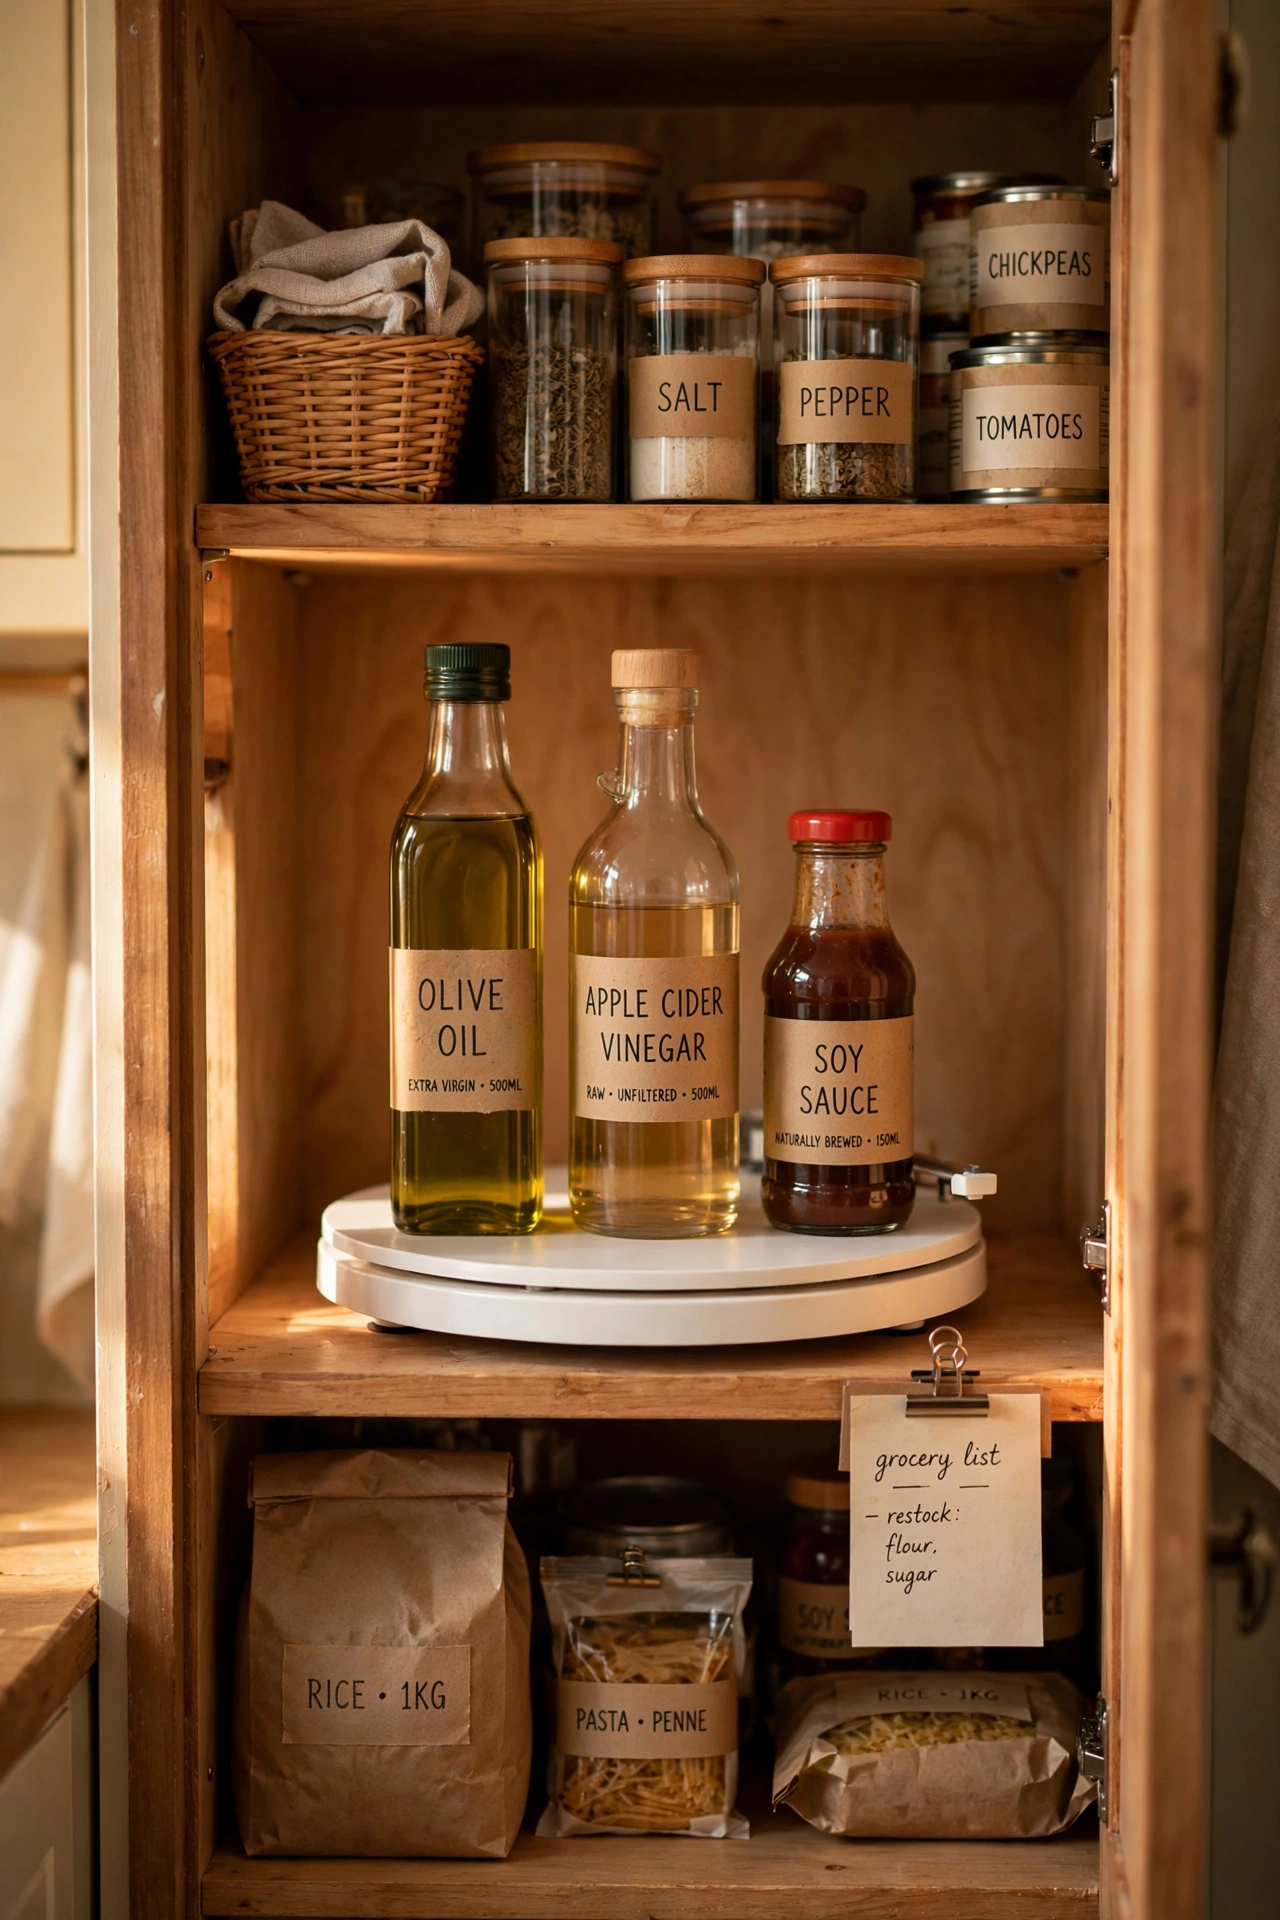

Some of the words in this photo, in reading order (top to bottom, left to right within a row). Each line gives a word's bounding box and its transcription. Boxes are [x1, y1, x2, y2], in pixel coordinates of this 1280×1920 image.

[988, 250, 1092, 279] CHICKPEAS
[657, 381, 723, 413] SALT
[800, 386, 892, 418] PEPPER
[976, 412, 1083, 442] TOMATOES
[418, 978, 504, 1012] OLIVE
[585, 985, 649, 1018] APPLE
[661, 985, 724, 1019] CIDER
[437, 1024, 487, 1057] OIL
[600, 1031, 707, 1064] VINEGAR
[814, 1043, 864, 1074] SOY
[408, 1078, 438, 1093] EXTRA
[441, 1079, 476, 1093] VIRGIN
[489, 1078, 522, 1092] 500ML
[586, 1084, 606, 1101] RAW
[617, 1087, 677, 1103] UNFILTERED
[691, 1085, 720, 1101] 500ML
[799, 1084, 879, 1116] SAUCE
[775, 1131, 821, 1149] NATURALLY
[824, 1134, 863, 1149] BREWED
[875, 1131, 901, 1147] 150ML
[874, 1451, 954, 1483] grocery
[963, 1441, 1001, 1468] list
[885, 1533, 938, 1563] flour,
[885, 1568, 938, 1595] sugar
[797, 1603, 836, 1631] SOY
[307, 1678, 366, 1710] RICE
[401, 1680, 447, 1711] 1KG
[877, 1688, 929, 1702] RICE
[960, 1688, 999, 1702] 1KG
[577, 1707, 631, 1734] PASTA
[651, 1708, 708, 1734] PENNE
